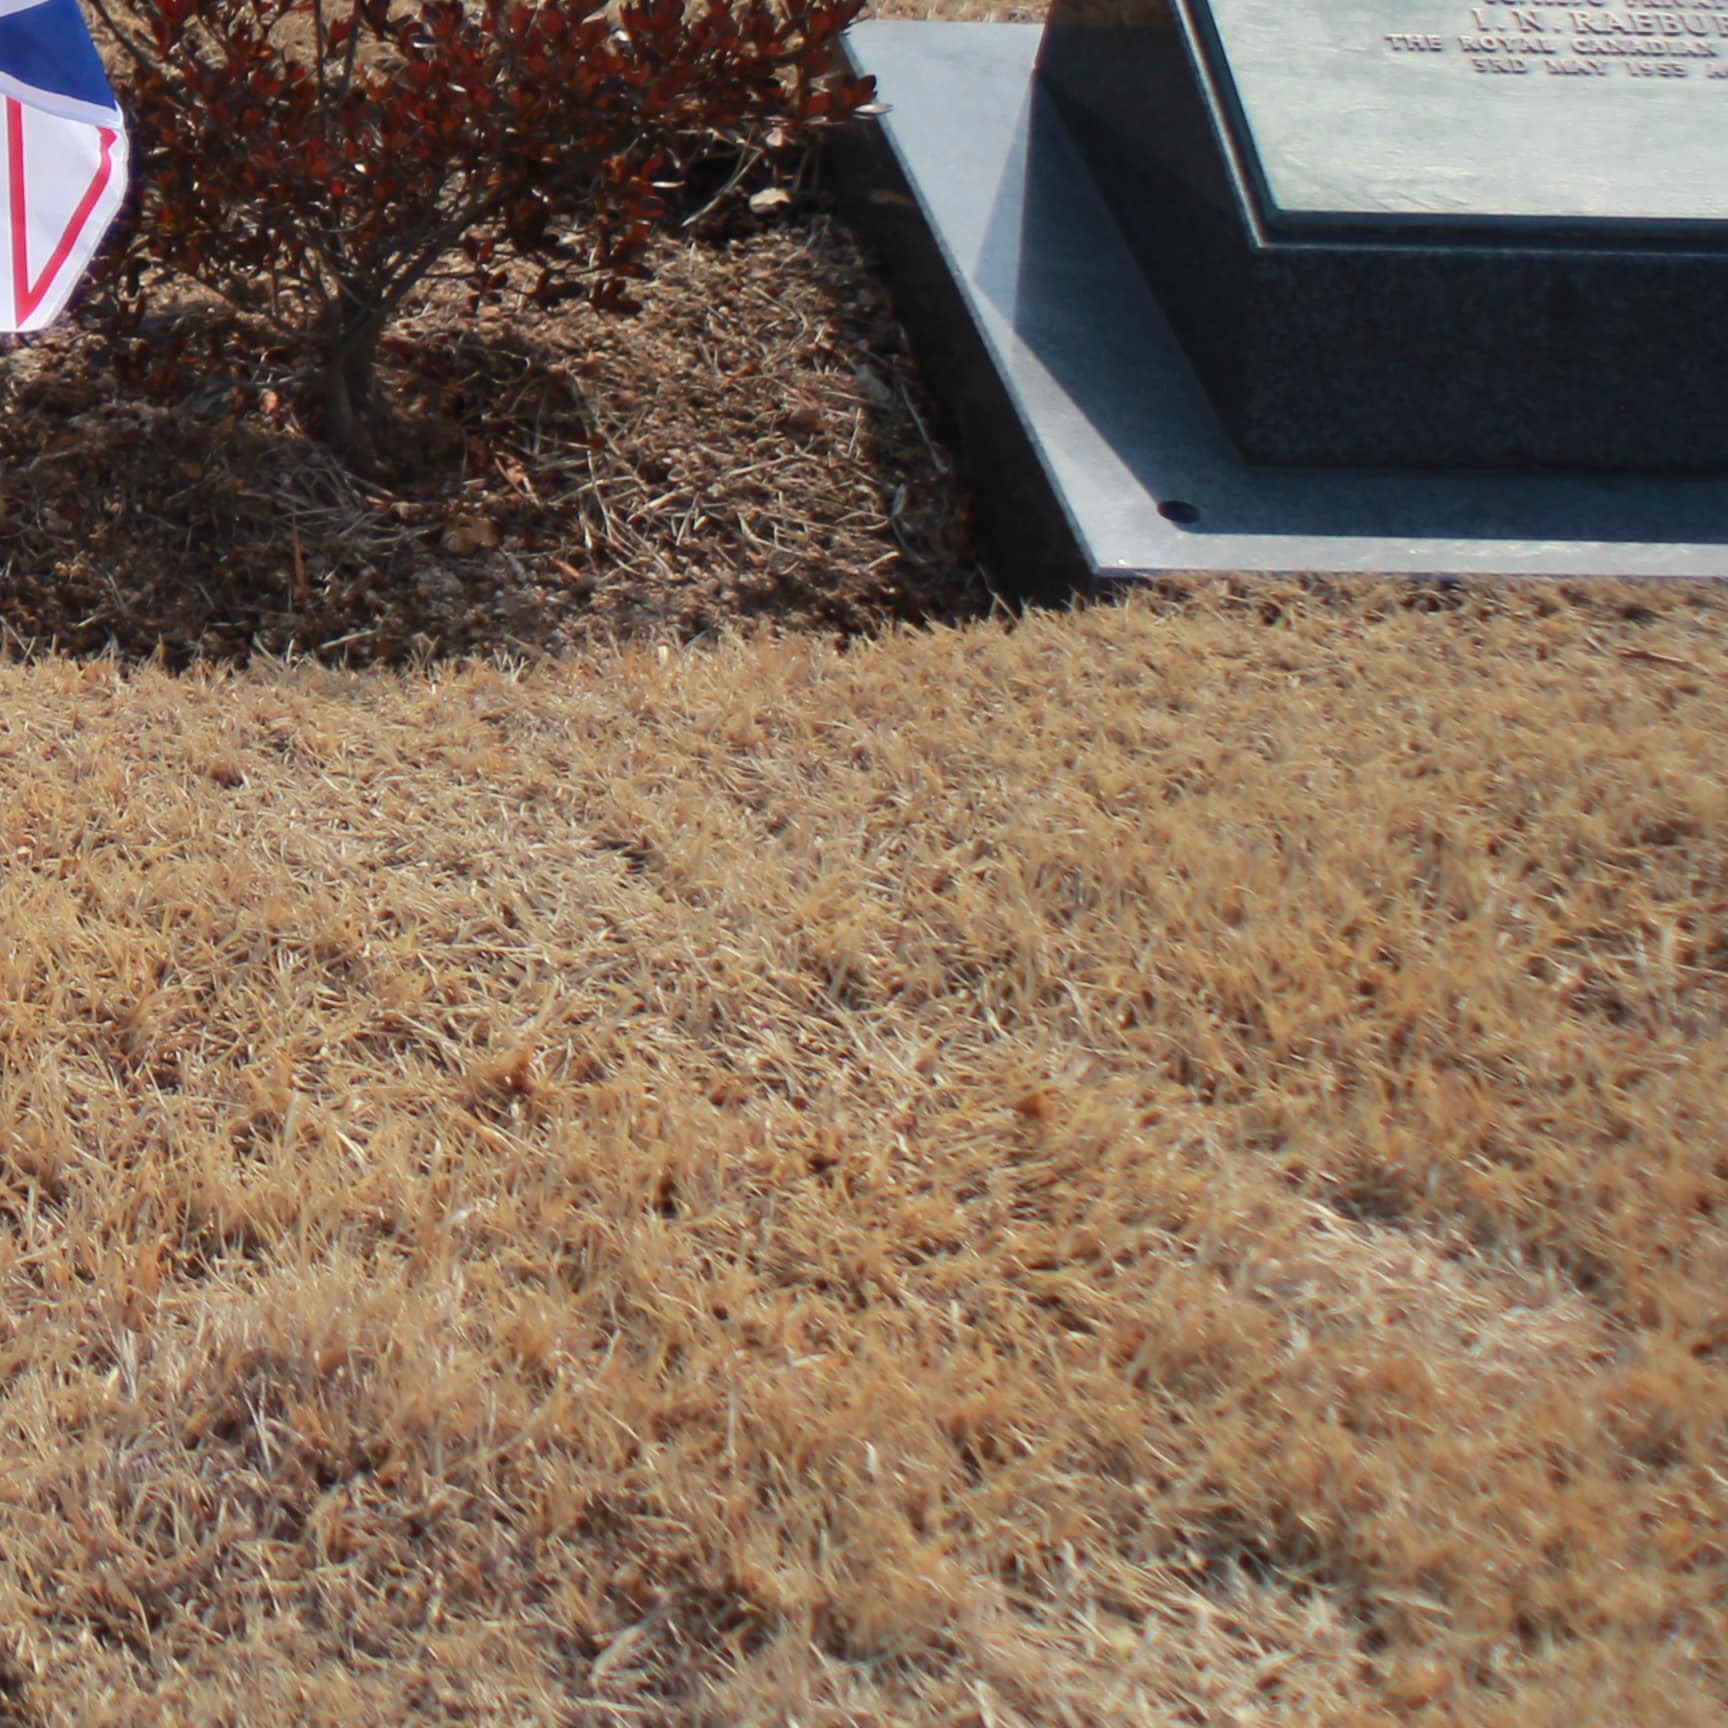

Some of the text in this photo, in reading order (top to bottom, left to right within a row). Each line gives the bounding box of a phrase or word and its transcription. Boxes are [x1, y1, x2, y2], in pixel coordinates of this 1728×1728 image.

[1384, 33, 1718, 59] THE ROYAL CANADIAN
[1542, 59, 1610, 77] MAY
